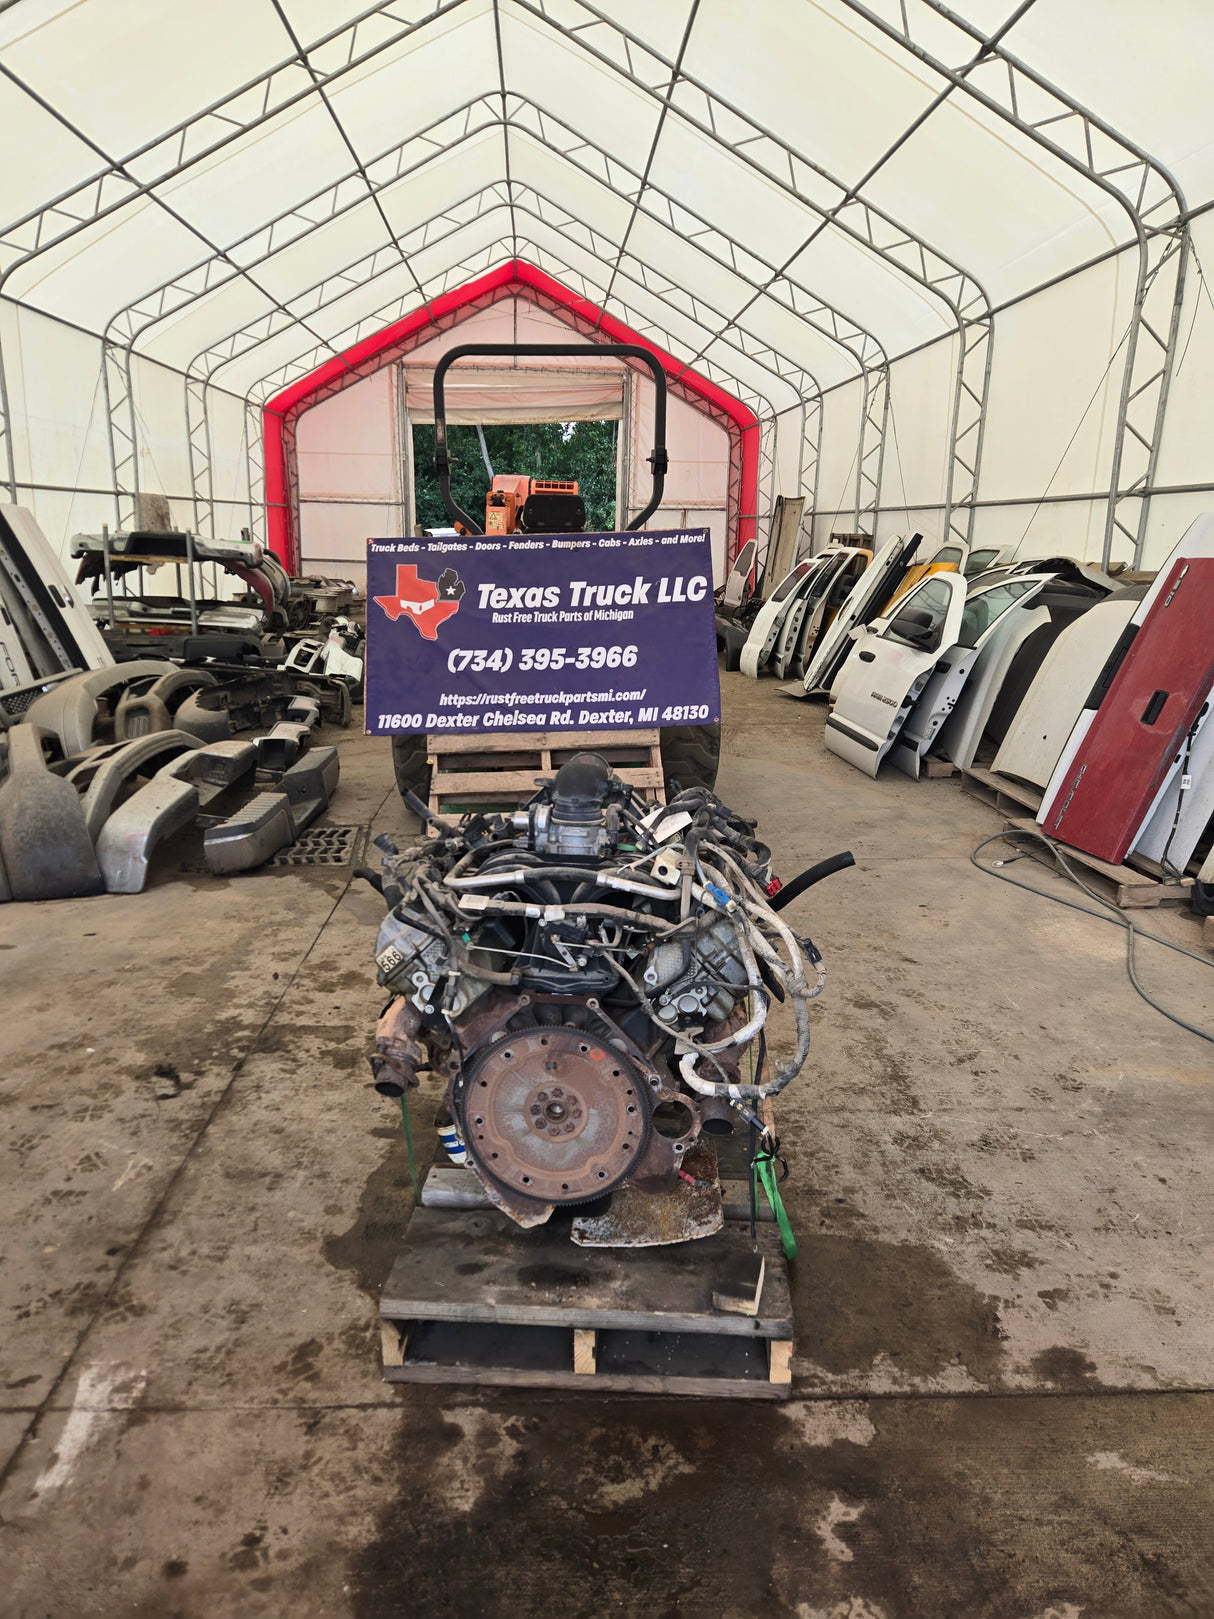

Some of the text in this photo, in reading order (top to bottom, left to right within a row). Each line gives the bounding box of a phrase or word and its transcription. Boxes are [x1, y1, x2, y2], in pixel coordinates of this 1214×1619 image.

[371, 543, 396, 552] Truck
[397, 543, 420, 552] Beds
[428, 542, 467, 553] Tailgates
[475, 542, 501, 550] Doors
[509, 540, 544, 549] Fenders
[552, 540, 590, 550] Bumpers
[599, 538, 621, 547] Cabs
[628, 537, 653, 546] Axles
[661, 535, 678, 544] and
[680, 533, 705, 543] More!
[478, 576, 708, 608] Texas Truck LLC
[492, 609, 633, 623] Rust Free Truck Parts of Michigan
[448, 645, 638, 673] (734) 395-3966
[439, 689, 647, 708] https://rustfreetruckpartsmi.com/
[378, 705, 709, 728] 11600 Dexter Chelsea Rd. Dexter, MI 48130
[1054, 764, 1088, 830] CHEVROLET
[381, 951, 401, 970] 566
